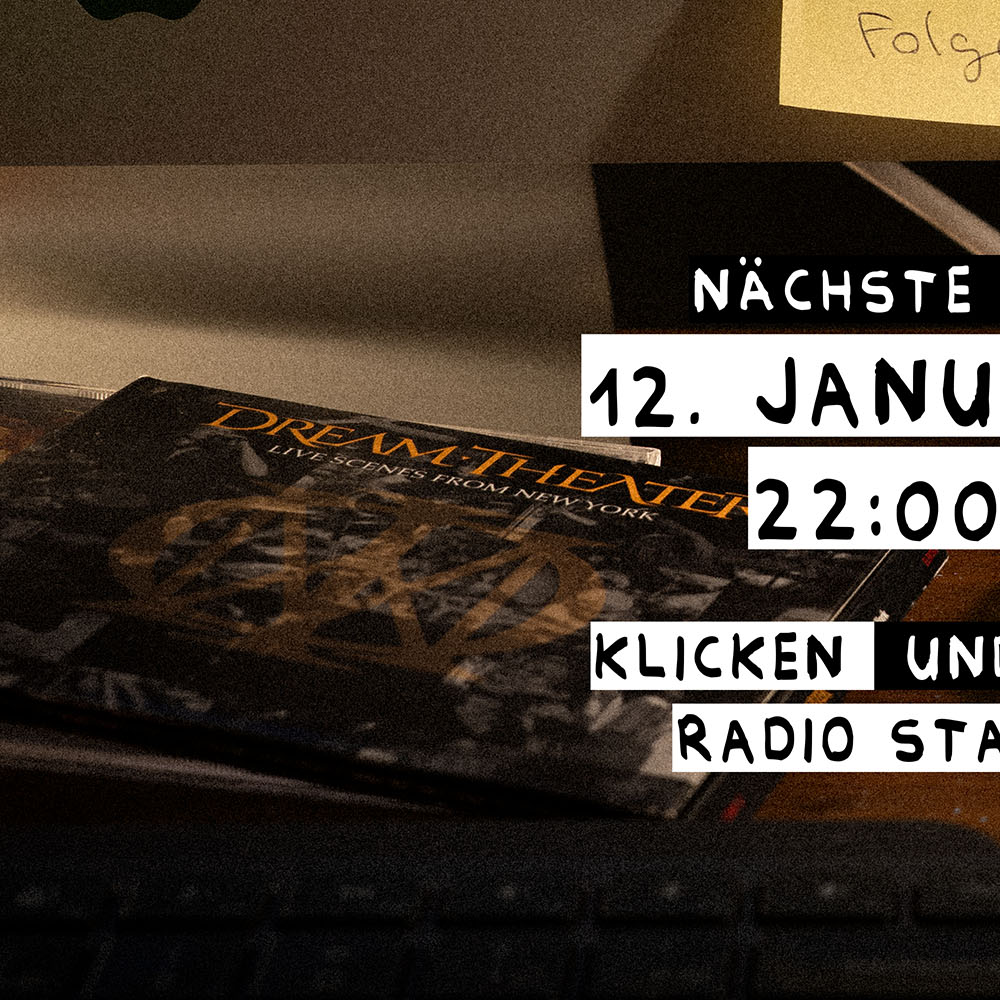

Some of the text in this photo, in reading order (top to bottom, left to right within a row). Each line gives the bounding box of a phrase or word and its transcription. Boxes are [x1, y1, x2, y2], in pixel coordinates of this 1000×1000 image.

[268, 445, 660, 521] LIVE SCENES FROM NEW YORK
